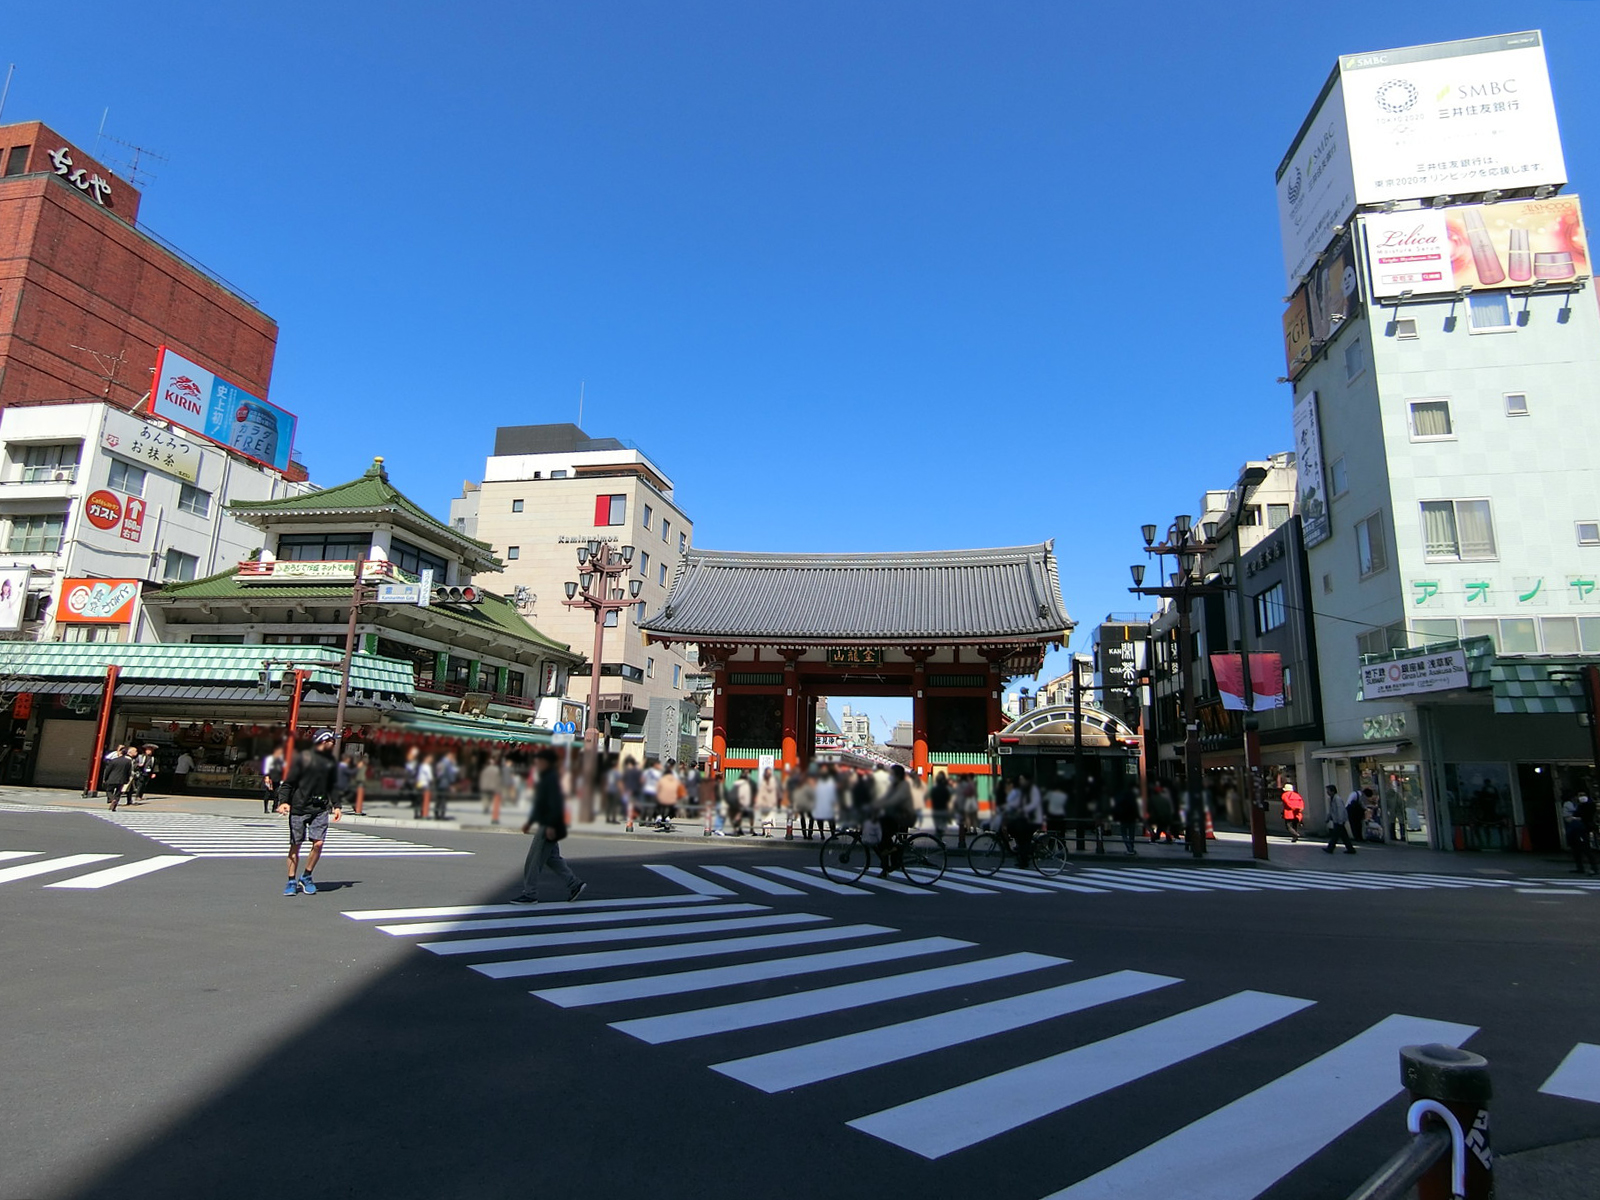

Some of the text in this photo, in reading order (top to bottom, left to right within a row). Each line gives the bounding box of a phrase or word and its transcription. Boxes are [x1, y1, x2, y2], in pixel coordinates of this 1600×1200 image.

[1357, 55, 1388, 67] SMBC
[1458, 79, 1517, 99] SMBC
[1438, 100, 1520, 119] 三井住友銀行
[48, 147, 111, 204] ちんや
[1376, 224, 1438, 248] Lilica
[165, 390, 202, 416] KIRIN
[140, 426, 190, 454] あんみつ
[239, 424, 273, 440] カラダ
[131, 440, 175, 467] お抹茶
[234, 435, 271, 456] FREE
[89, 504, 119, 521] ガスト
[1414, 579, 1595, 605] アオノヤ
[1365, 668, 1386, 679] 地下鉄
[1401, 656, 1454, 673] 銀座線 浅草駅
[1429, 668, 1452, 676] Asakusa
